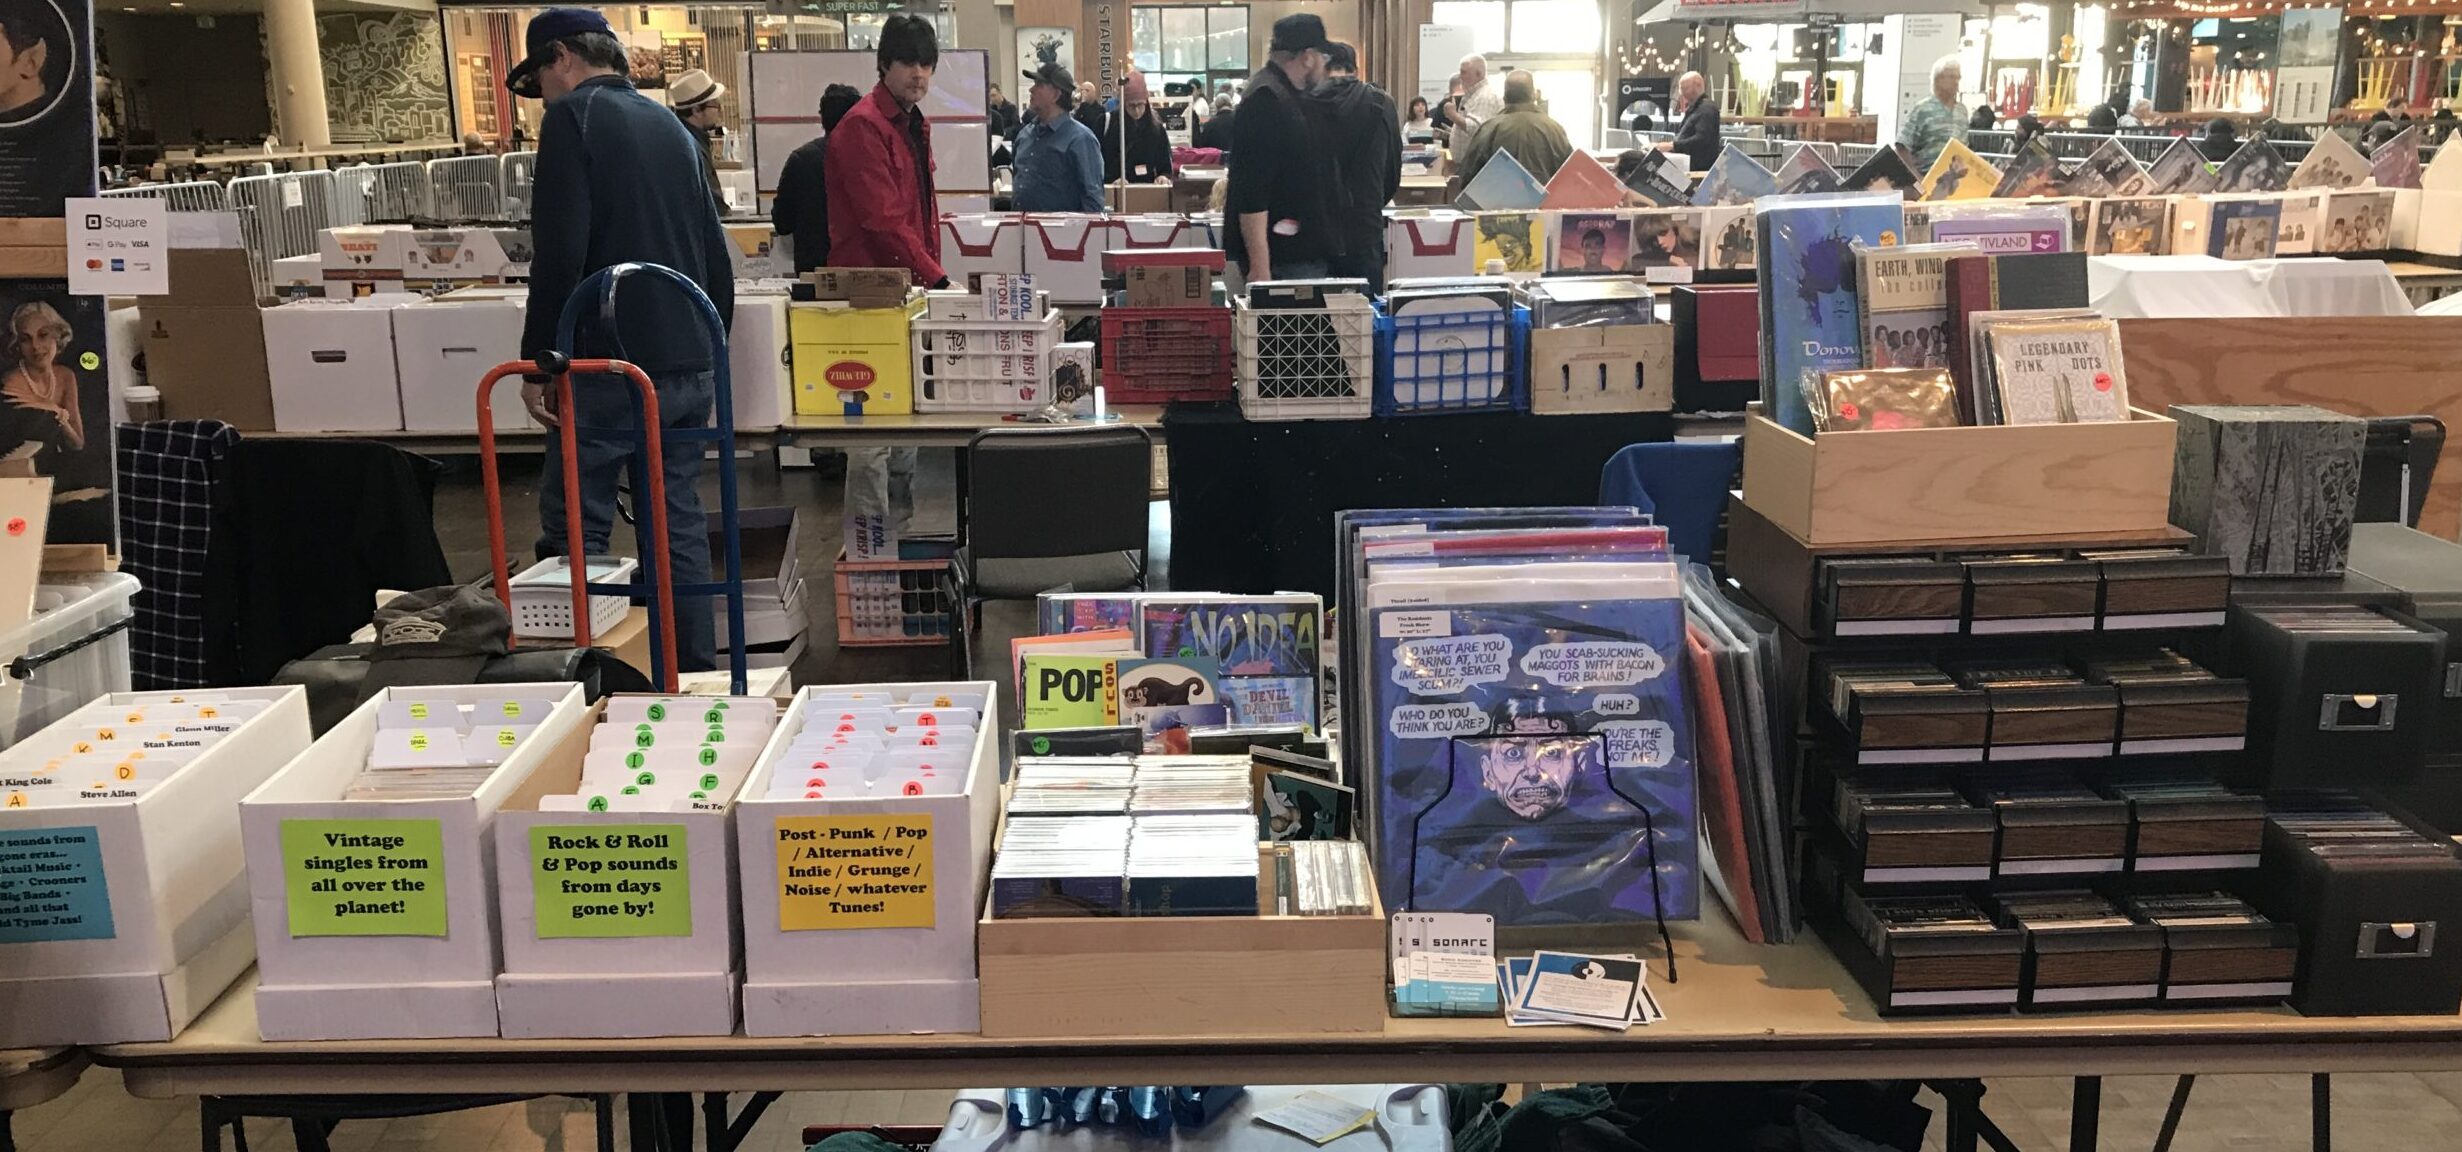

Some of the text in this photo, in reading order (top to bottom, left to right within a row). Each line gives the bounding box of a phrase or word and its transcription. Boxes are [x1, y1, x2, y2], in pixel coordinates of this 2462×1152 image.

[826, 3, 856, 11] SUPER
[1099, 6, 1112, 105] STARBUCK
[105, 217, 147, 229] Square
[1875, 258, 1943, 277] EARTH, WIND
[2021, 342, 2088, 356] LEGENDARY
[2015, 358, 2102, 372] PINK DOTS
[829, 370, 852, 381] WHIZ
[1247, 608, 1316, 668] IDEA
[1422, 641, 1505, 654] WHAT ARE YOU
[1540, 648, 1643, 659] YOU SCAB-SUCKING
[1456, 655, 1470, 666] AT,
[1474, 654, 1496, 663] YOU
[1528, 660, 1654, 671] MAGGOTS WITH BACON
[1461, 664, 1501, 676] SEWER
[1558, 672, 1579, 682] FOR
[1040, 669, 1102, 702] POP
[1249, 689, 1289, 702] DEVIL
[651, 707, 660, 720] S
[710, 713, 718, 722] R
[1399, 707, 1469, 720] WHO DO YOU
[922, 717, 931, 726] T
[1396, 722, 1428, 732] THINK
[1432, 721, 1453, 731] YOU
[1640, 728, 1662, 738] THE
[638, 736, 649, 746] M
[632, 754, 638, 767] I
[704, 751, 714, 763] H
[120, 768, 129, 778] D
[5, 779, 28, 787] King
[639, 775, 650, 785] G
[705, 776, 716, 787] F
[909, 785, 917, 795] B
[10, 795, 20, 807] A
[592, 799, 604, 811] A
[780, 830, 816, 840] Post
[829, 828, 875, 839] Punk
[896, 827, 927, 839] Pop
[7, 836, 85, 847] sounds from
[324, 834, 404, 850] Vintage
[548, 835, 668, 849] Rock & Roll
[806, 846, 903, 858] Alternative
[35, 863, 72, 872] Music
[305, 856, 428, 872] singles from
[543, 857, 677, 873] & Pop sounds
[788, 866, 831, 877] Indie
[848, 865, 910, 878] Grunge
[28, 877, 86, 886] Crooners
[312, 878, 424, 891] all over the
[562, 880, 661, 895] from days
[22, 890, 61, 900] Bands
[785, 884, 830, 896] Noise
[847, 883, 927, 894] whatever
[23, 904, 39, 913] all
[42, 904, 69, 912] that
[335, 901, 404, 916] planet!
[573, 901, 653, 918] gone by!
[829, 901, 884, 913] Tunes!
[13, 918, 49, 928] Tyme
[1434, 938, 1487, 946] sonarc
